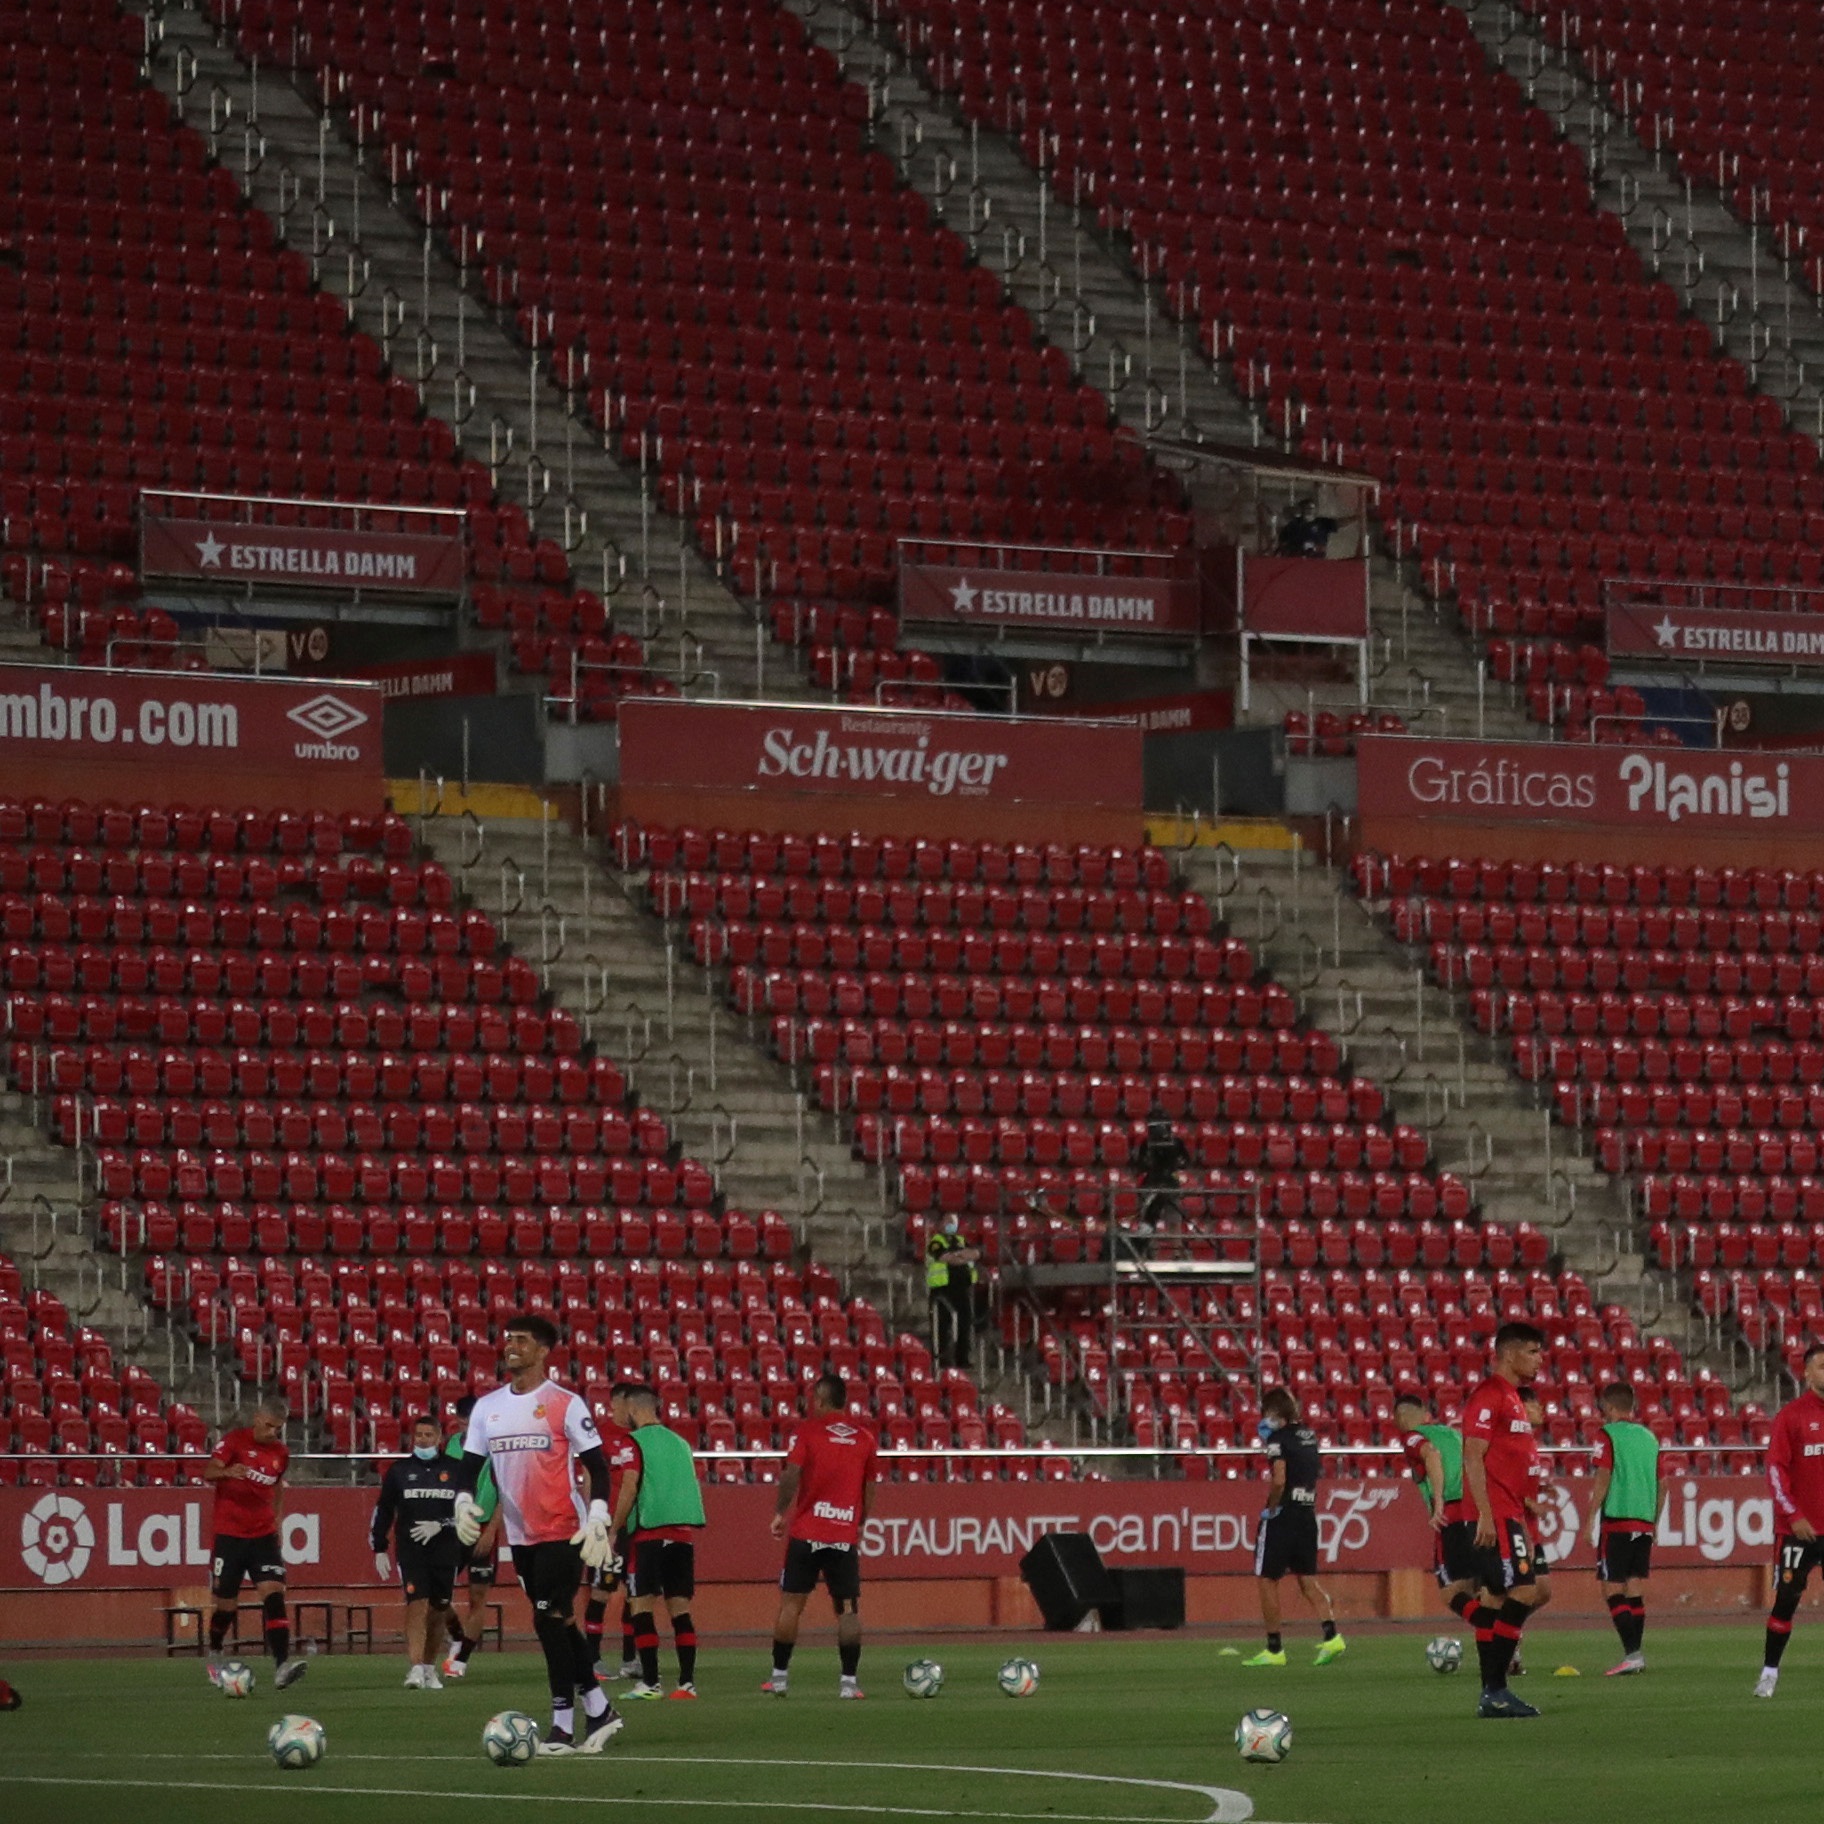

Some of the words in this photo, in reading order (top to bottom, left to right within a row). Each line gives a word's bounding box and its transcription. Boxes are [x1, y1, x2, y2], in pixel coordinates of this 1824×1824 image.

[231, 545, 339, 574] ESTRELLA
[345, 552, 416, 578] DAMM
[982, 591, 1083, 618] ESTRELLA
[1088, 595, 1155, 621] DAMM
[1684, 627, 1780, 653] ESTRELLA
[295, 742, 359, 761] umbro
[1408, 757, 1597, 807] Gráficas
[489, 1434, 550, 1452] BETFRED
[403, 1487, 455, 1500] BETFRED
[813, 1500, 855, 1522] fibwi
[108, 1503, 320, 1566] LaLa
[858, 1515, 1080, 1557] STAURANT
[1513, 1534, 1528, 1558] 5
[1782, 1546, 1804, 1569] 17
